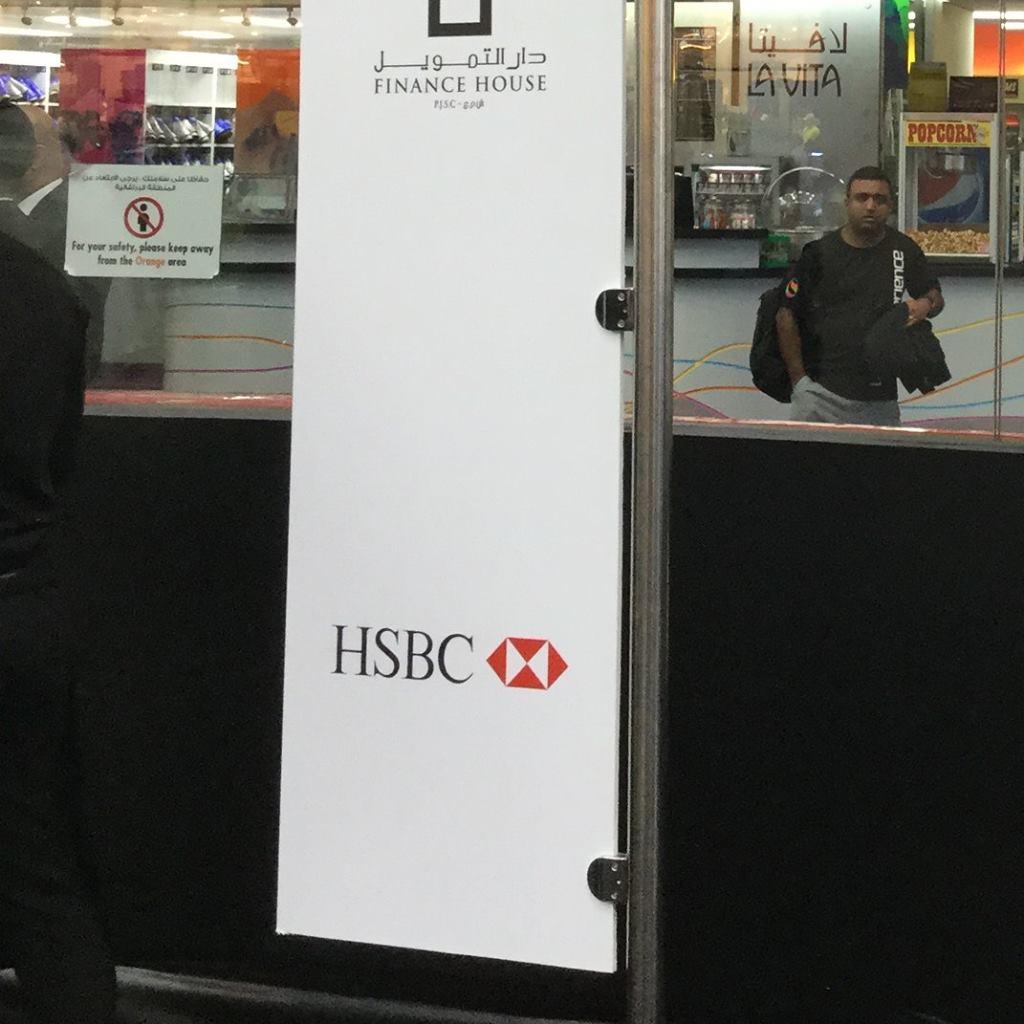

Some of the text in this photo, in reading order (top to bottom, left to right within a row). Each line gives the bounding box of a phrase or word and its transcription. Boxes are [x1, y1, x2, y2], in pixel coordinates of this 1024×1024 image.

[374, 47, 547, 73] دار التمويل
[374, 75, 547, 94] FINANCE HOUSE
[782, 63, 841, 96] VITA
[907, 122, 977, 144] POPCORN
[72, 240, 214, 256] For your safety, please keep away
[97, 255, 187, 269] from the Orange area
[330, 625, 474, 684] HSBC
